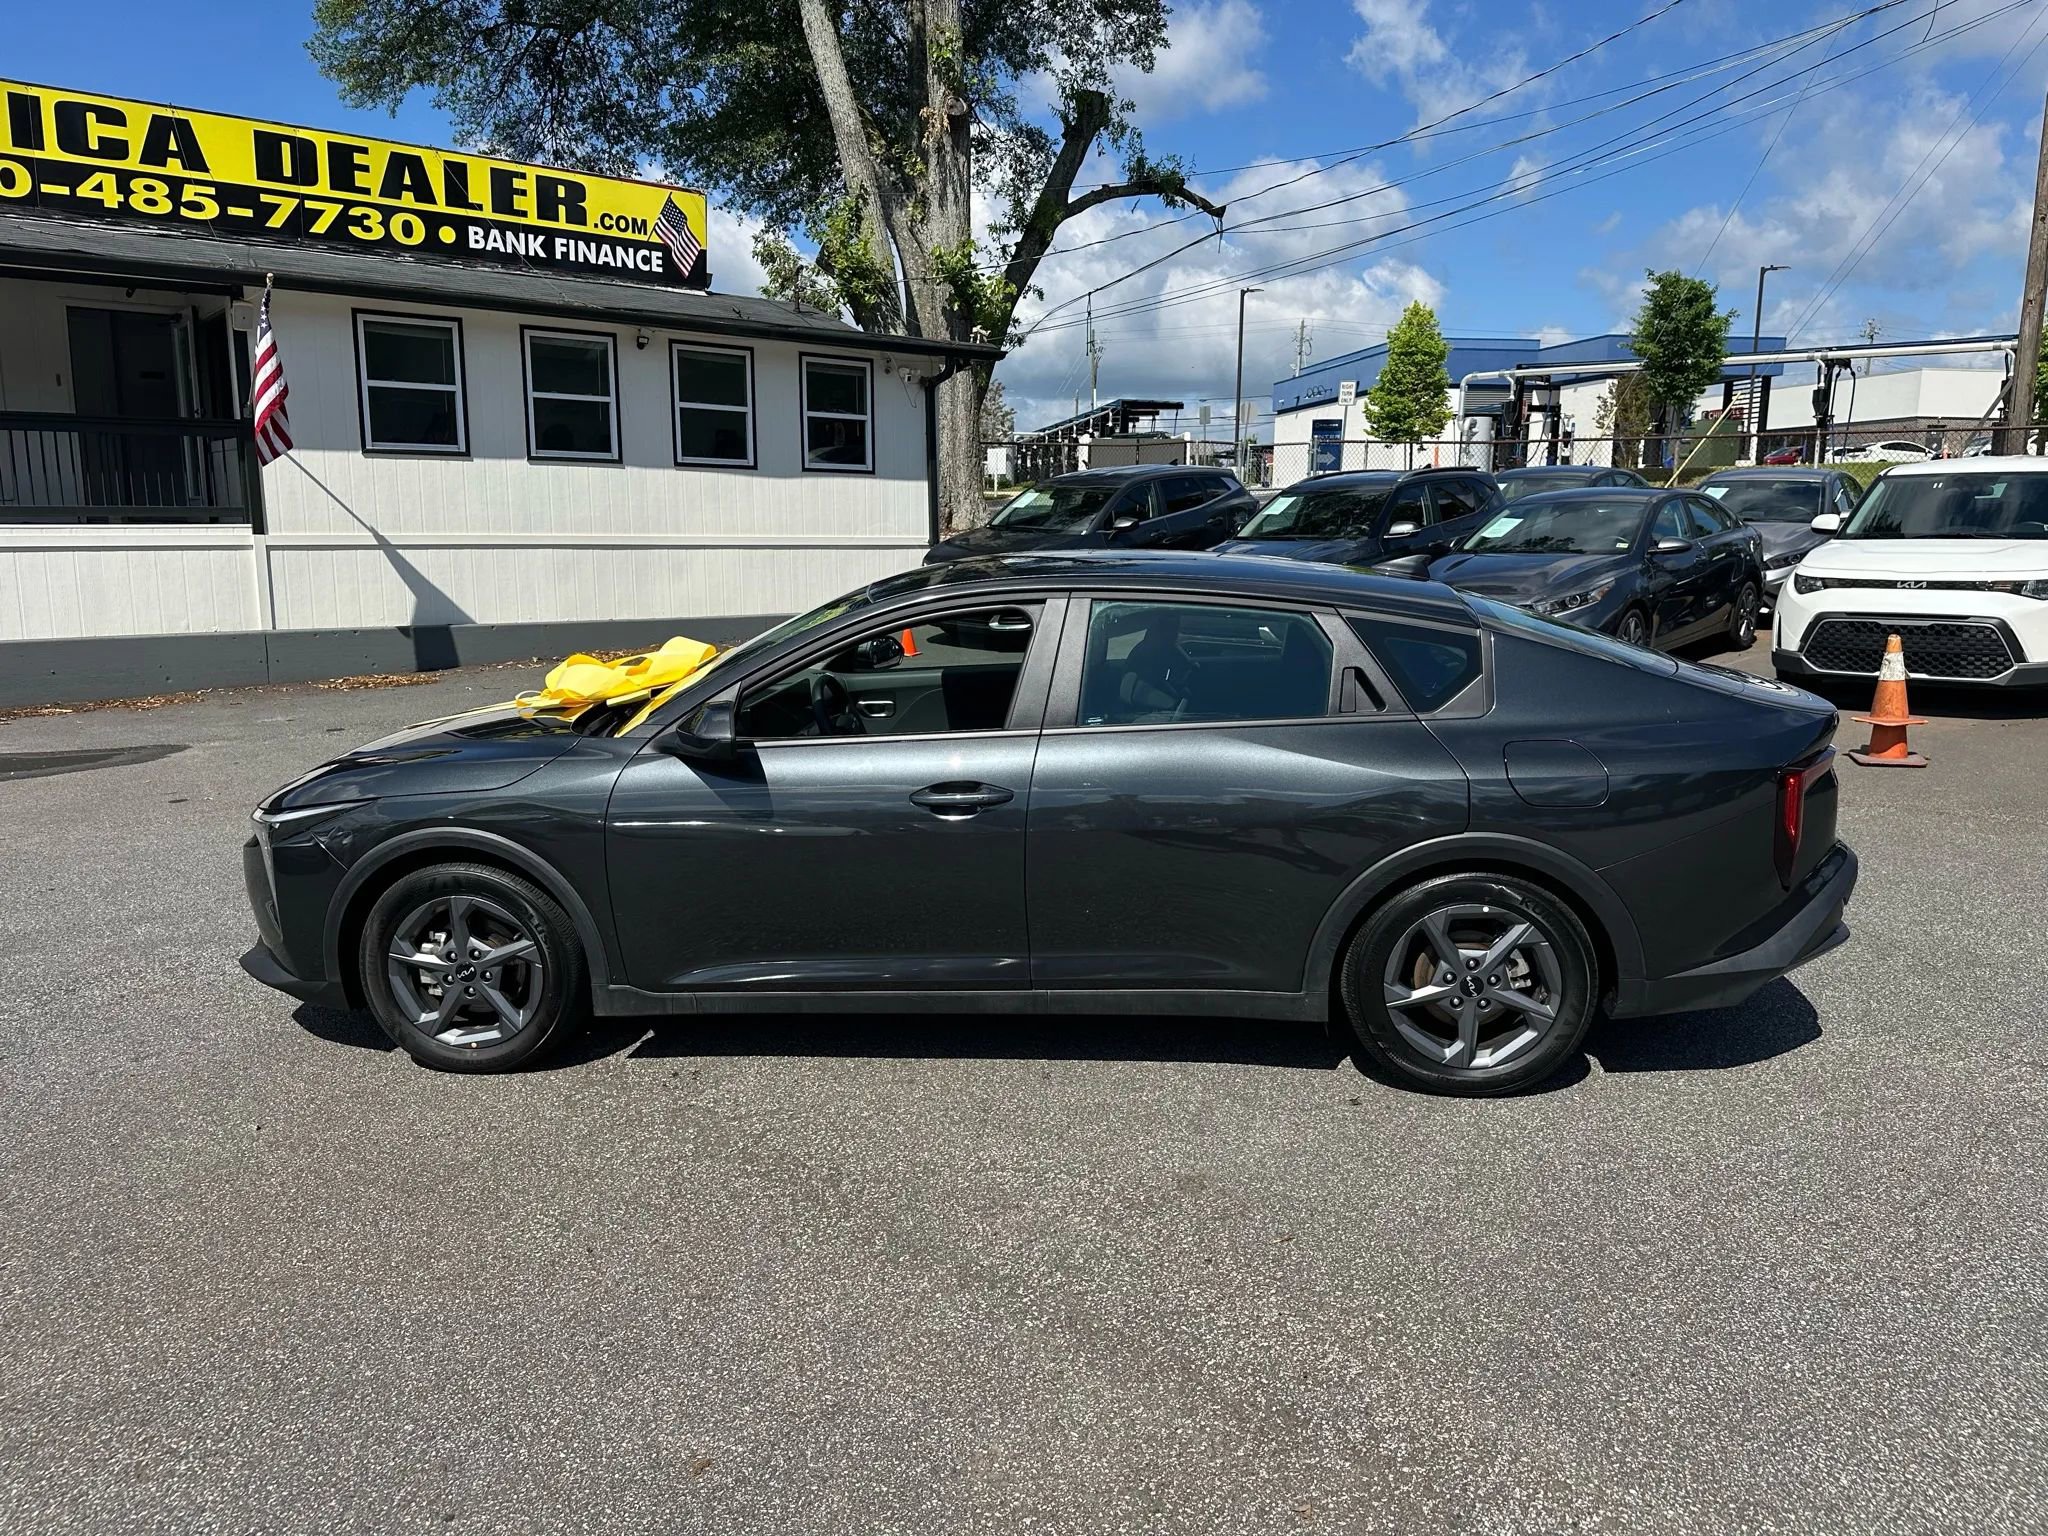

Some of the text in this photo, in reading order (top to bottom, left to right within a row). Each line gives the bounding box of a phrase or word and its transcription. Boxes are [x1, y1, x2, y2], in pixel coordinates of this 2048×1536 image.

[6, 91, 211, 173] ICA
[253, 129, 587, 226] DEALER
[468, 225, 547, 258] BANK
[555, 237, 663, 273] FINANCE
[1896, 581, 1927, 589] KIA
